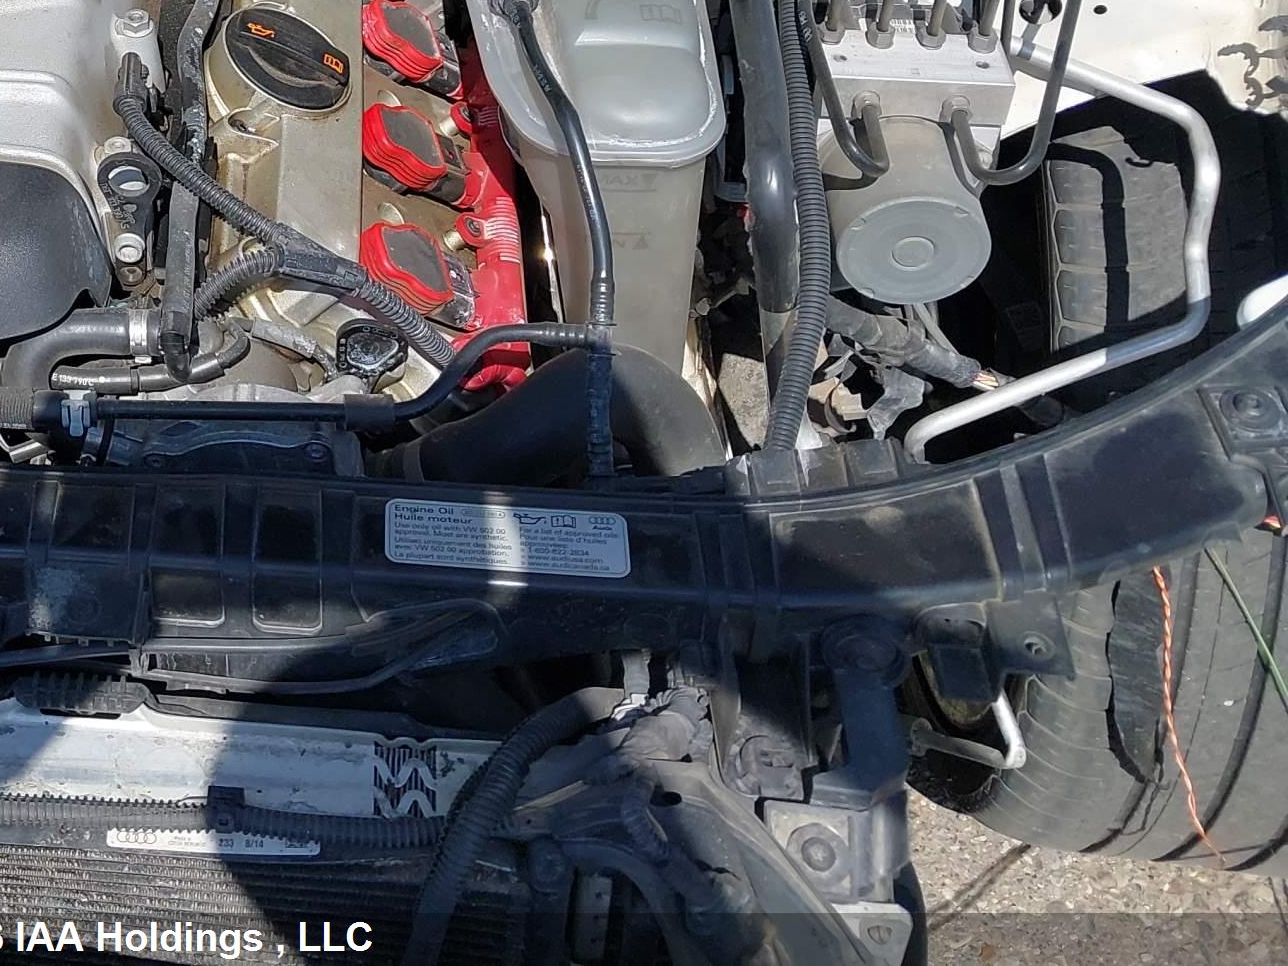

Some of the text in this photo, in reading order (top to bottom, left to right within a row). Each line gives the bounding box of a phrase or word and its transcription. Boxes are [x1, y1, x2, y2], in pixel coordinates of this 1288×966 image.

[394, 504, 434, 514] Engine
[438, 507, 454, 515] Oil
[394, 513, 473, 524] Huile moteur
[412, 523, 429, 531] only
